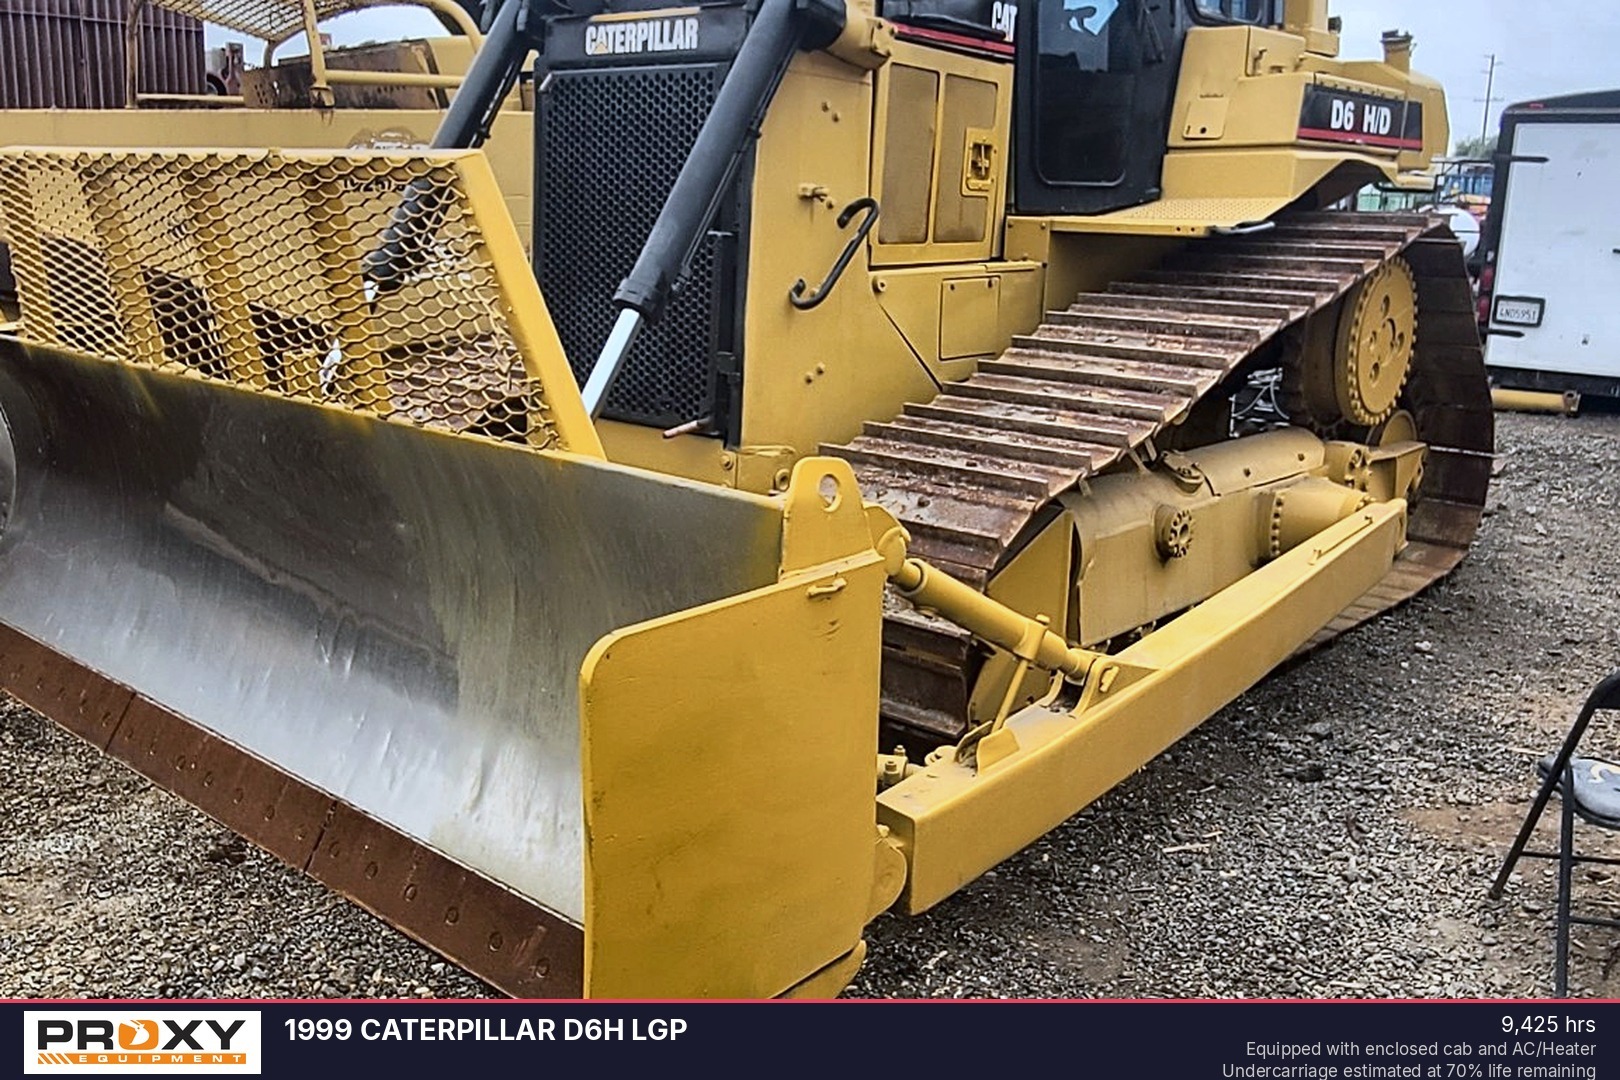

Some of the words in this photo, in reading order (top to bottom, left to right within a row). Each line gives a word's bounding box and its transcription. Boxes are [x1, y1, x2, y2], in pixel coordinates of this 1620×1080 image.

[585, 18, 698, 55] CATERPILLAR
[991, 1, 1018, 42] CAT
[1330, 99, 1355, 131] D6
[1362, 104, 1391, 135] H/D
